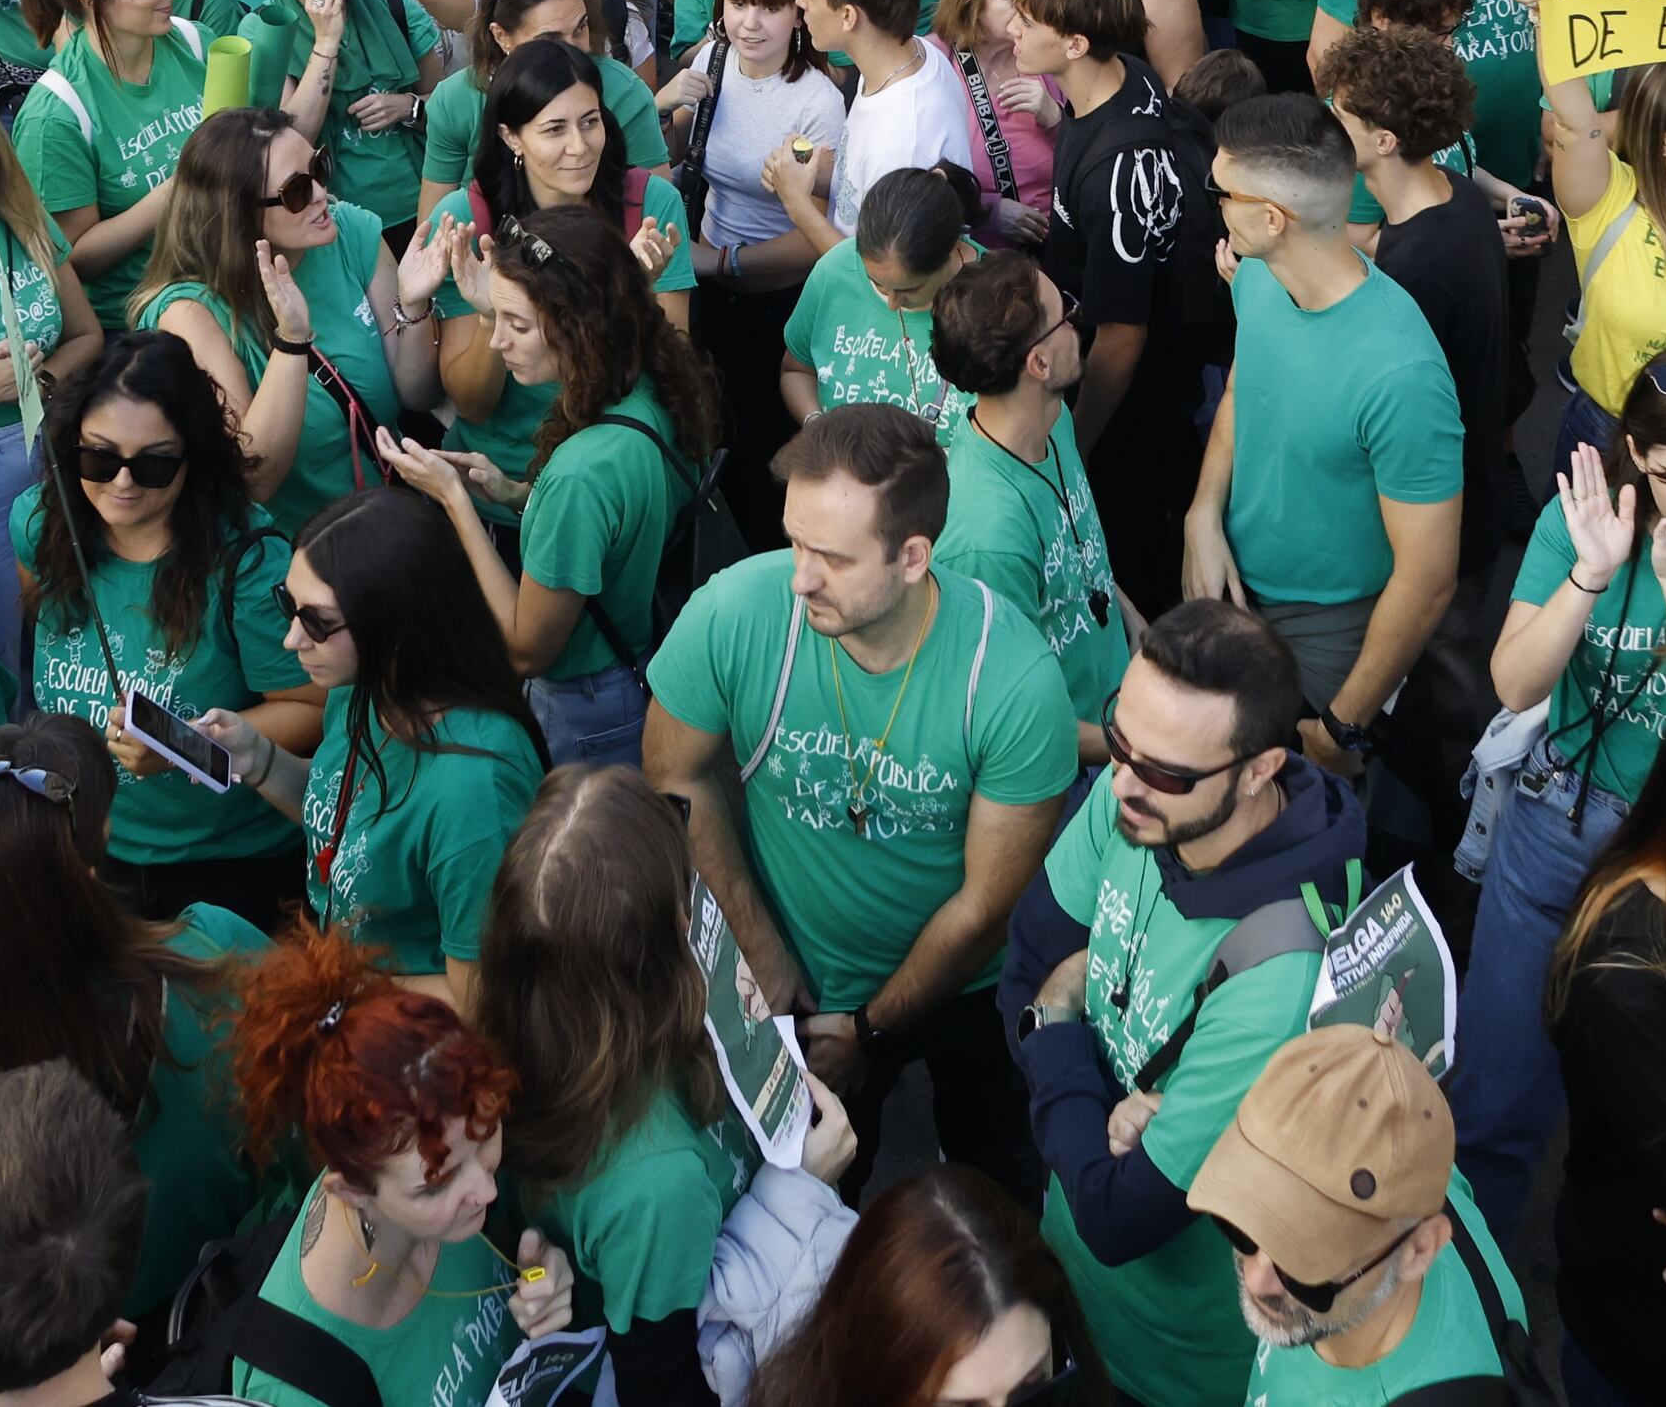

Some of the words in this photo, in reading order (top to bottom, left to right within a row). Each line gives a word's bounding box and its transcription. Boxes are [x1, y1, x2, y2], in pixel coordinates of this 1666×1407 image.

[1567, 9, 1627, 69] DE
[774, 722, 869, 766] ESCUELA
[1369, 908, 1416, 967] INDEFINIDA
